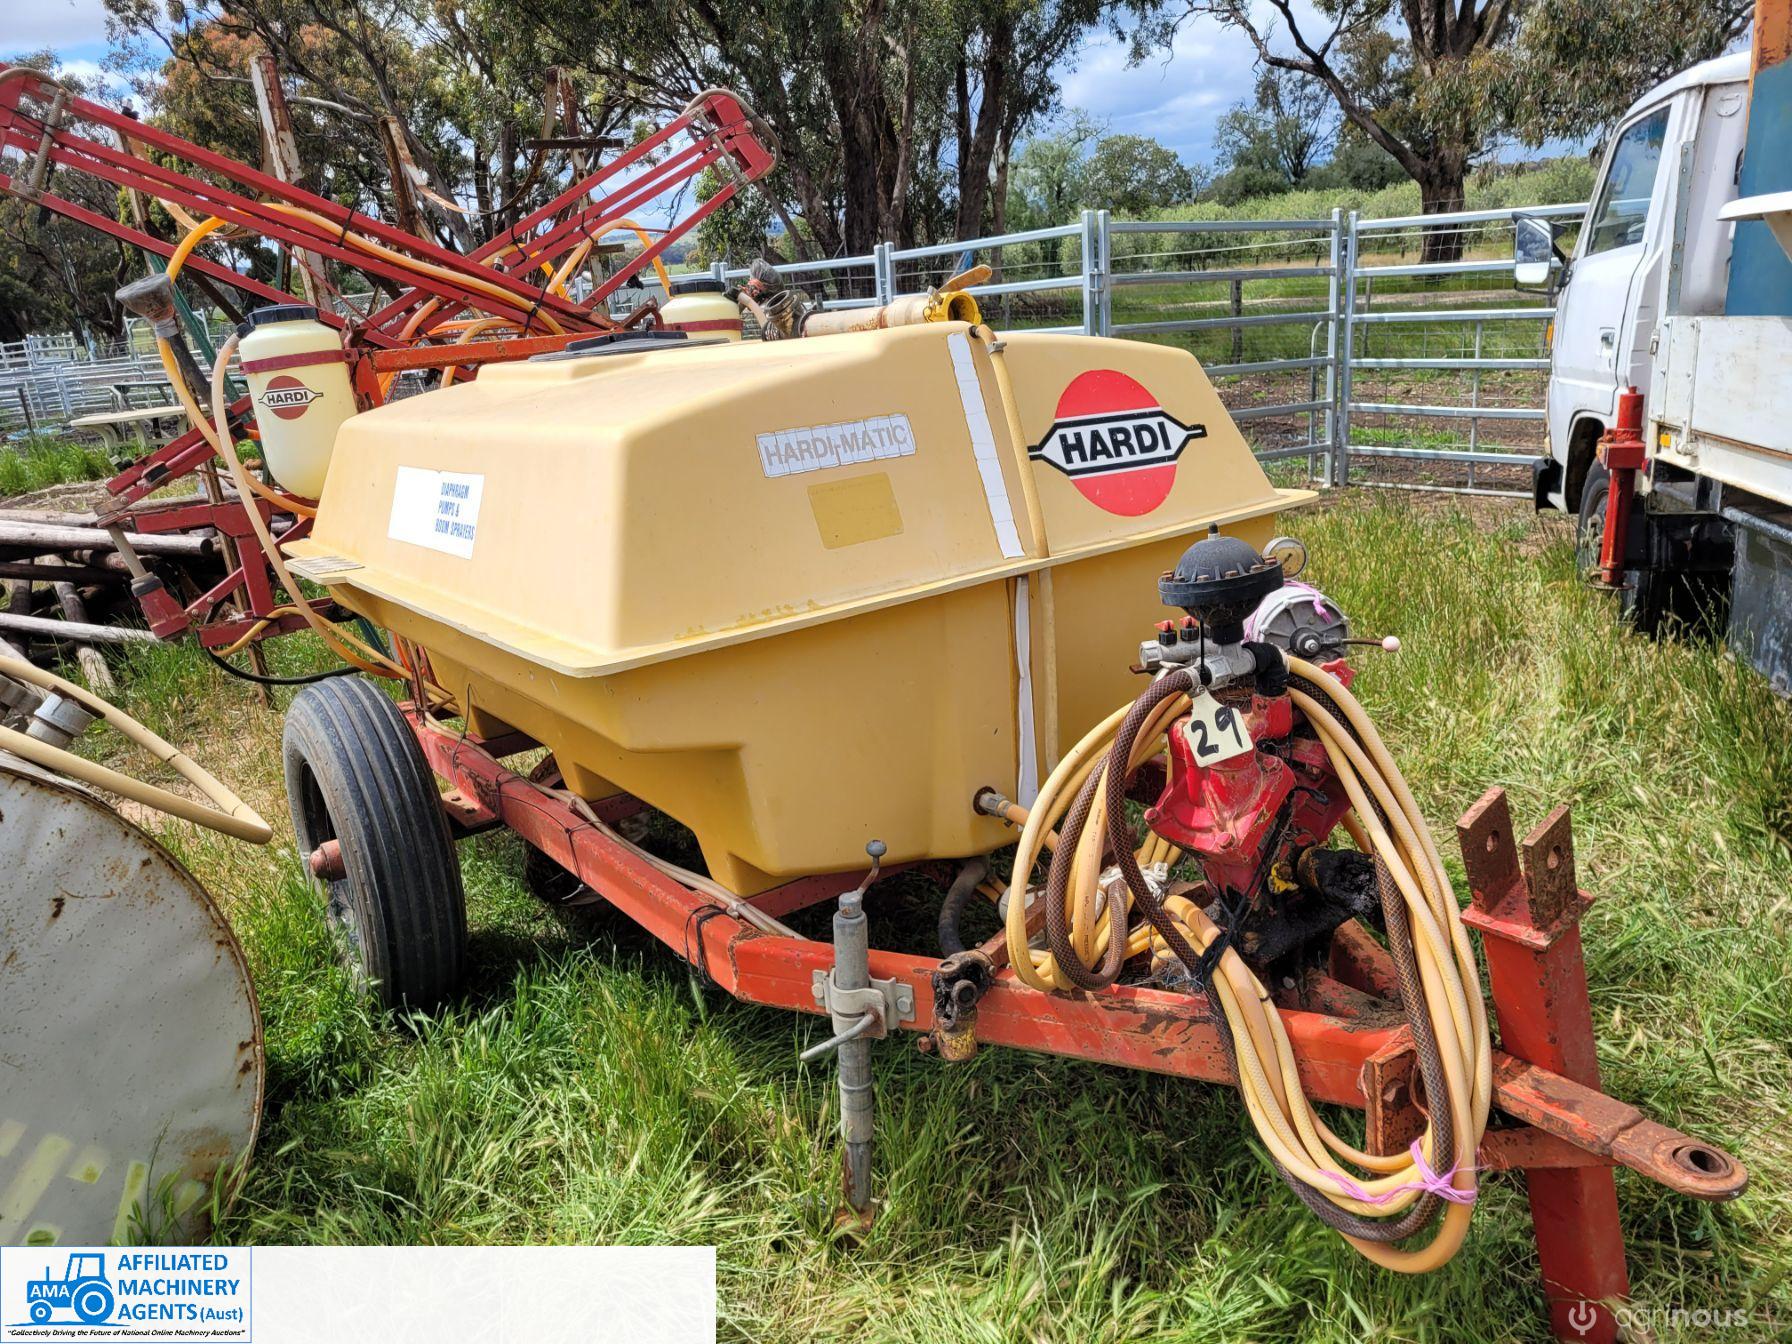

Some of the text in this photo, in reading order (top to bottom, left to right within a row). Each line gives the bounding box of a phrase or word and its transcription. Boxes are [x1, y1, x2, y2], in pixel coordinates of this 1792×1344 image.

[267, 391, 309, 405] HARDI
[764, 424, 908, 467] HARDI-MATIC
[1058, 421, 1172, 465] HARDI
[1190, 705, 1243, 758] 29
